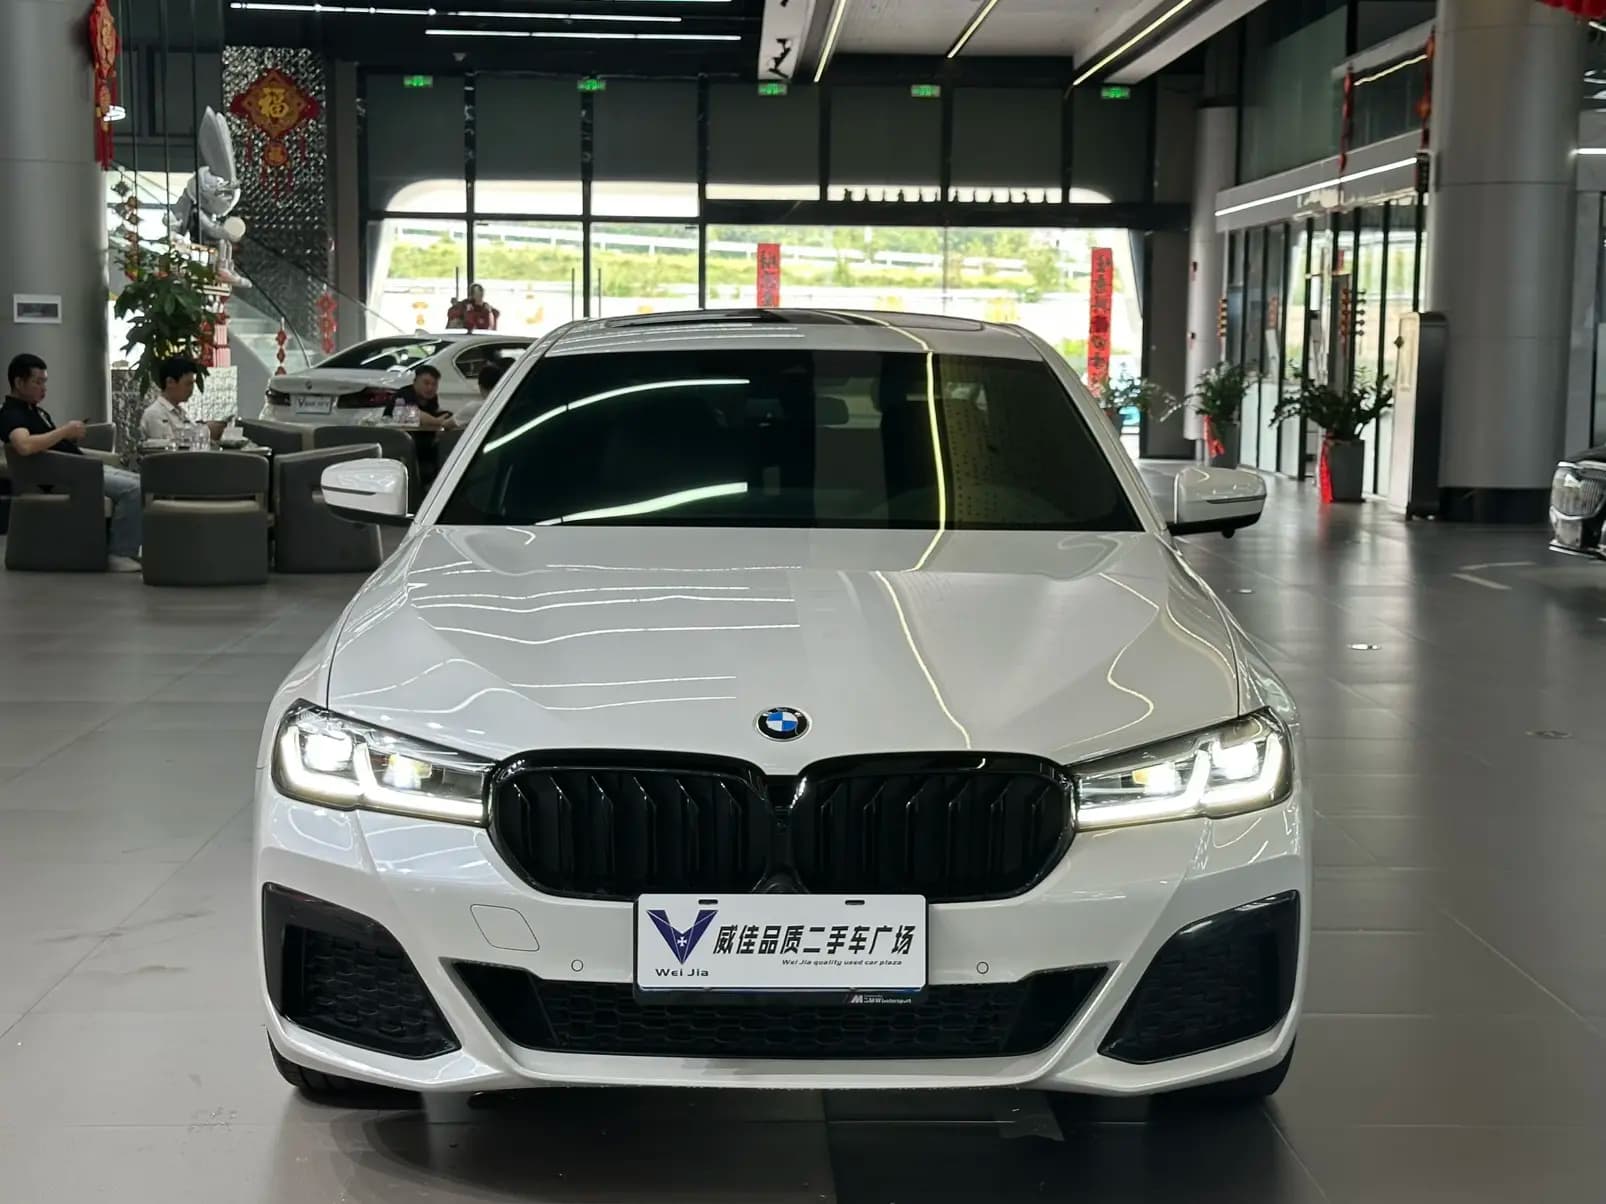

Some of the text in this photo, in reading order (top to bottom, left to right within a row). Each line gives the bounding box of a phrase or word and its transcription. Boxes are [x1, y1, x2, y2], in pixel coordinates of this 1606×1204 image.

[713, 924, 916, 955] 威佳品质二手车广场
[813, 959, 843, 967] quality
[879, 959, 902, 967] plaza
[655, 968, 710, 977] Wei Jia
